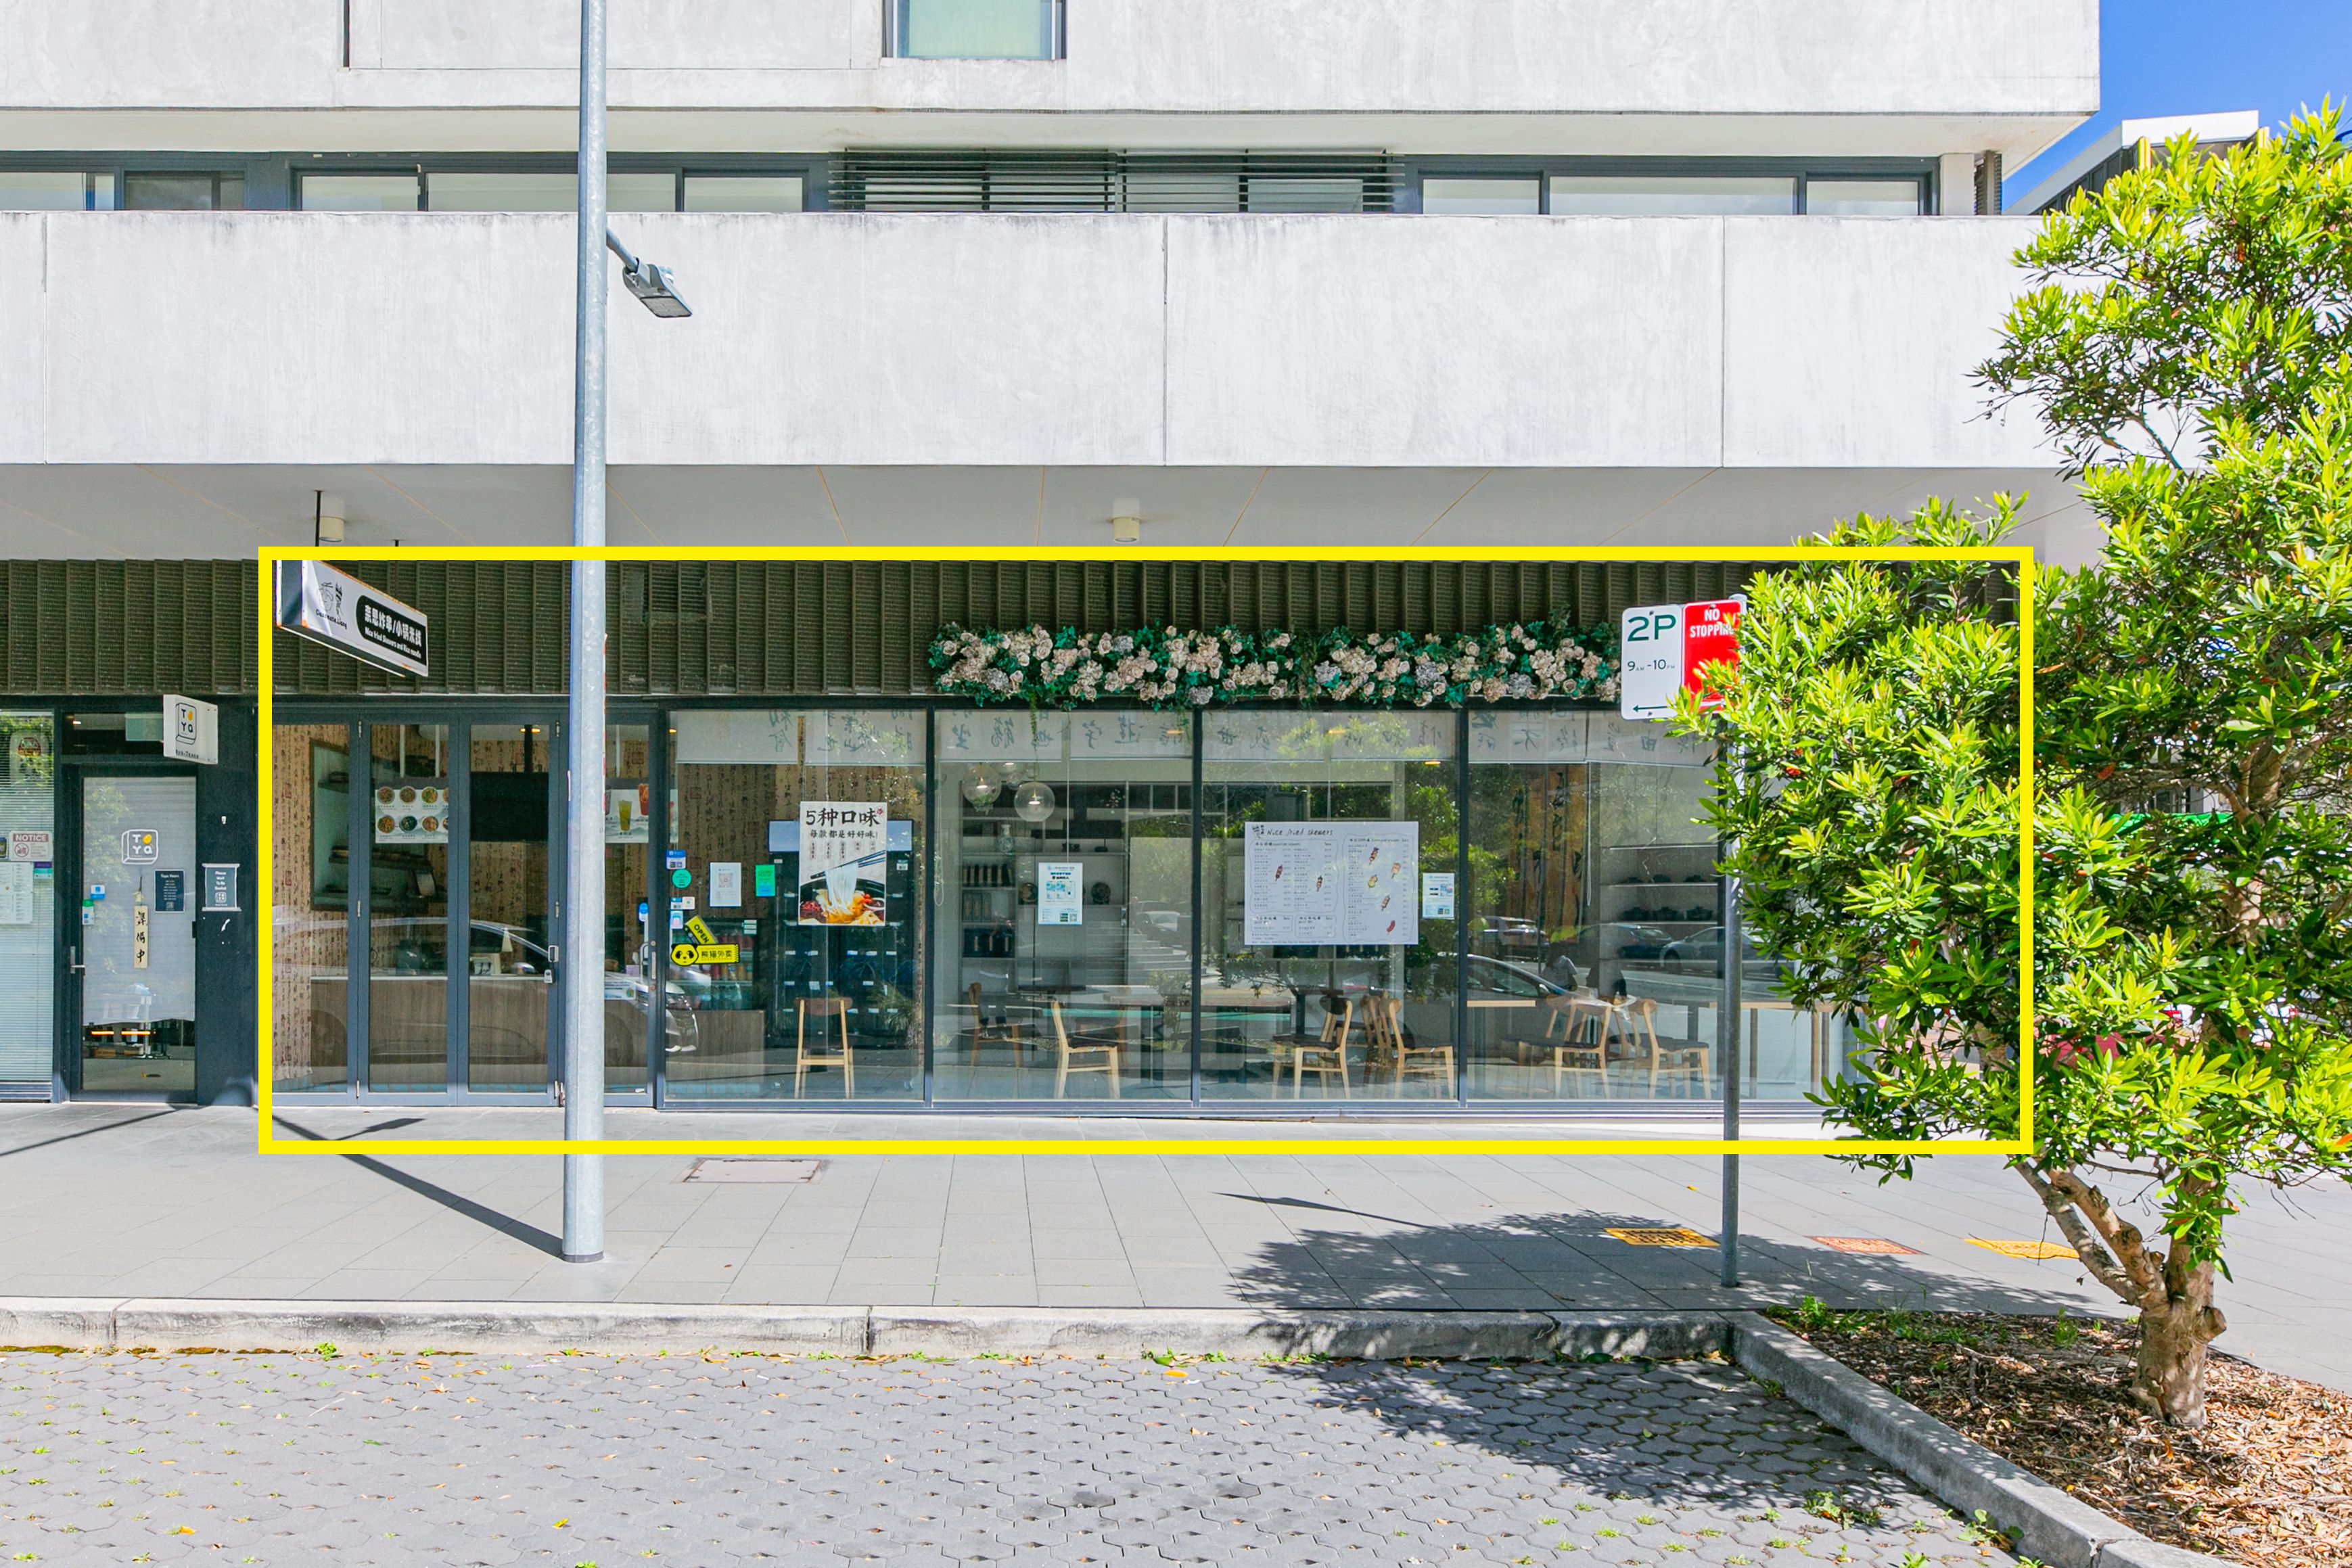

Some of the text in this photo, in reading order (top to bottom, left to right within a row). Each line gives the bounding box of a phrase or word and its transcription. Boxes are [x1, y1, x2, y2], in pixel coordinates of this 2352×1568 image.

[1704, 608, 1720, 621] NO
[1627, 614, 1677, 642] 2P
[806, 807, 881, 827] 5种口味
[694, 924, 710, 944] OPEN
